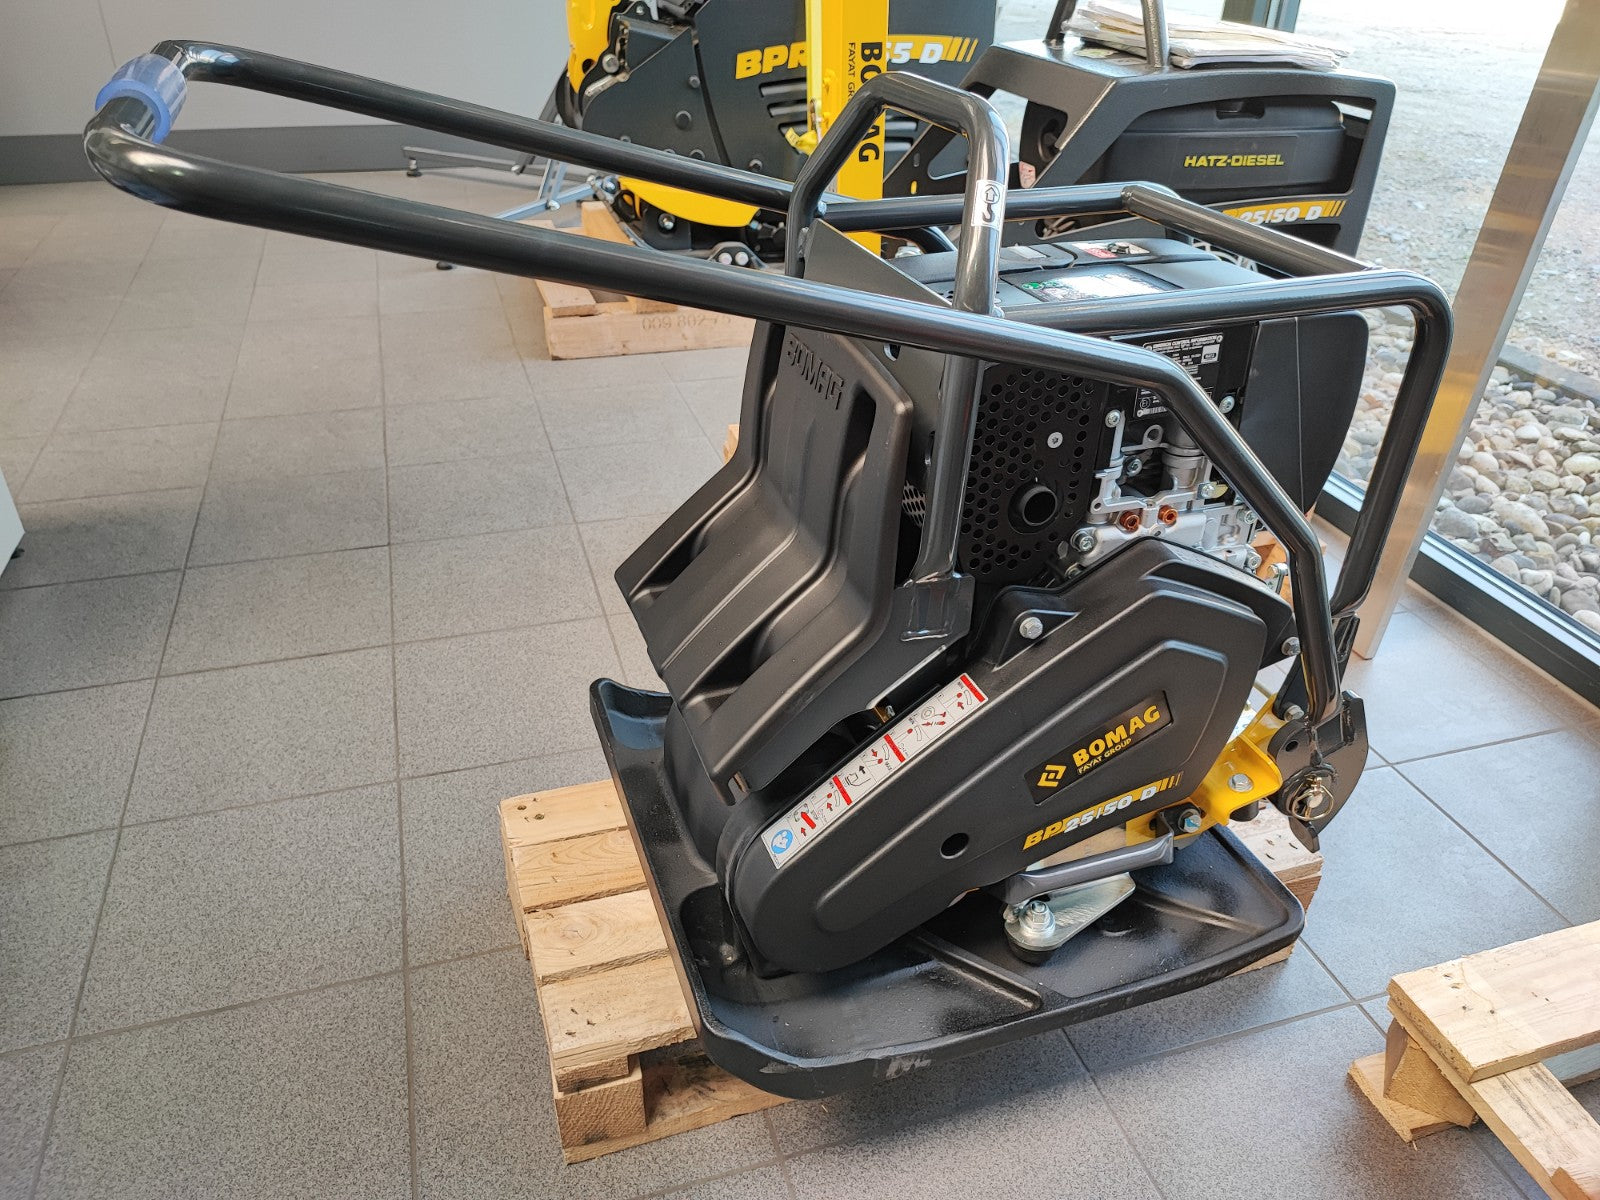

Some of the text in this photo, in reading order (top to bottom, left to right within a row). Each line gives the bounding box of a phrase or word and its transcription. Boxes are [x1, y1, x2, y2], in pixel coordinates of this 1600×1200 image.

[847, 42, 856, 77] FAYAT
[918, 42, 944, 64] D
[1183, 154, 1285, 168] HATZ-DIESEL
[1305, 205, 1323, 221] D
[786, 333, 845, 410] BOMAG
[1072, 705, 1161, 768] BOMAG
[1078, 738, 1132, 775] FAYAT GROUP
[1139, 786, 1158, 801] D
